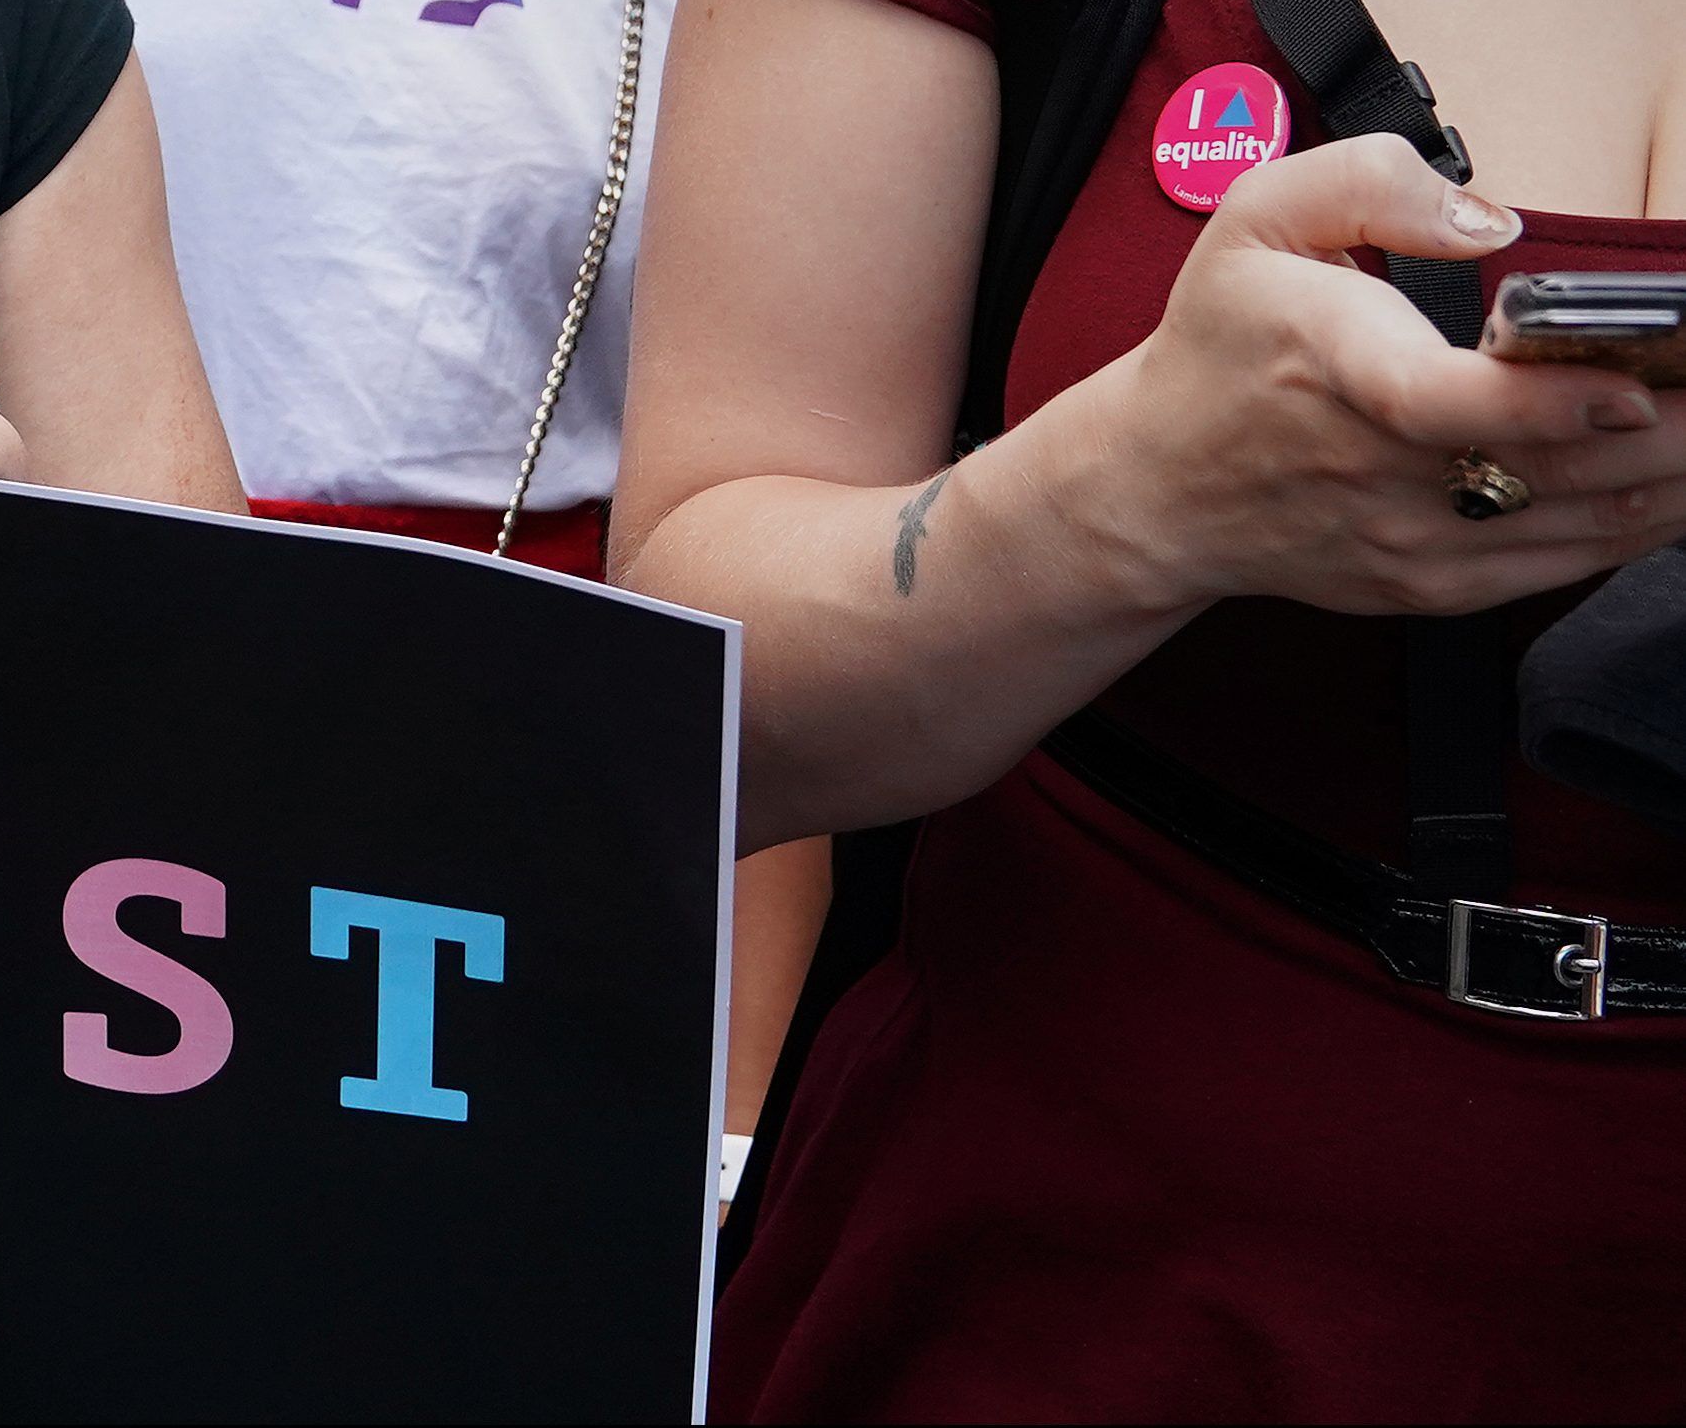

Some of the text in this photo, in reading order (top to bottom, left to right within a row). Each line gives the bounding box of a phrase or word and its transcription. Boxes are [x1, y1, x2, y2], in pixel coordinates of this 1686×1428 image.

[1188, 88, 1205, 130] I
[1155, 130, 1277, 170] equality
[1173, 183, 1212, 205] Lambda
